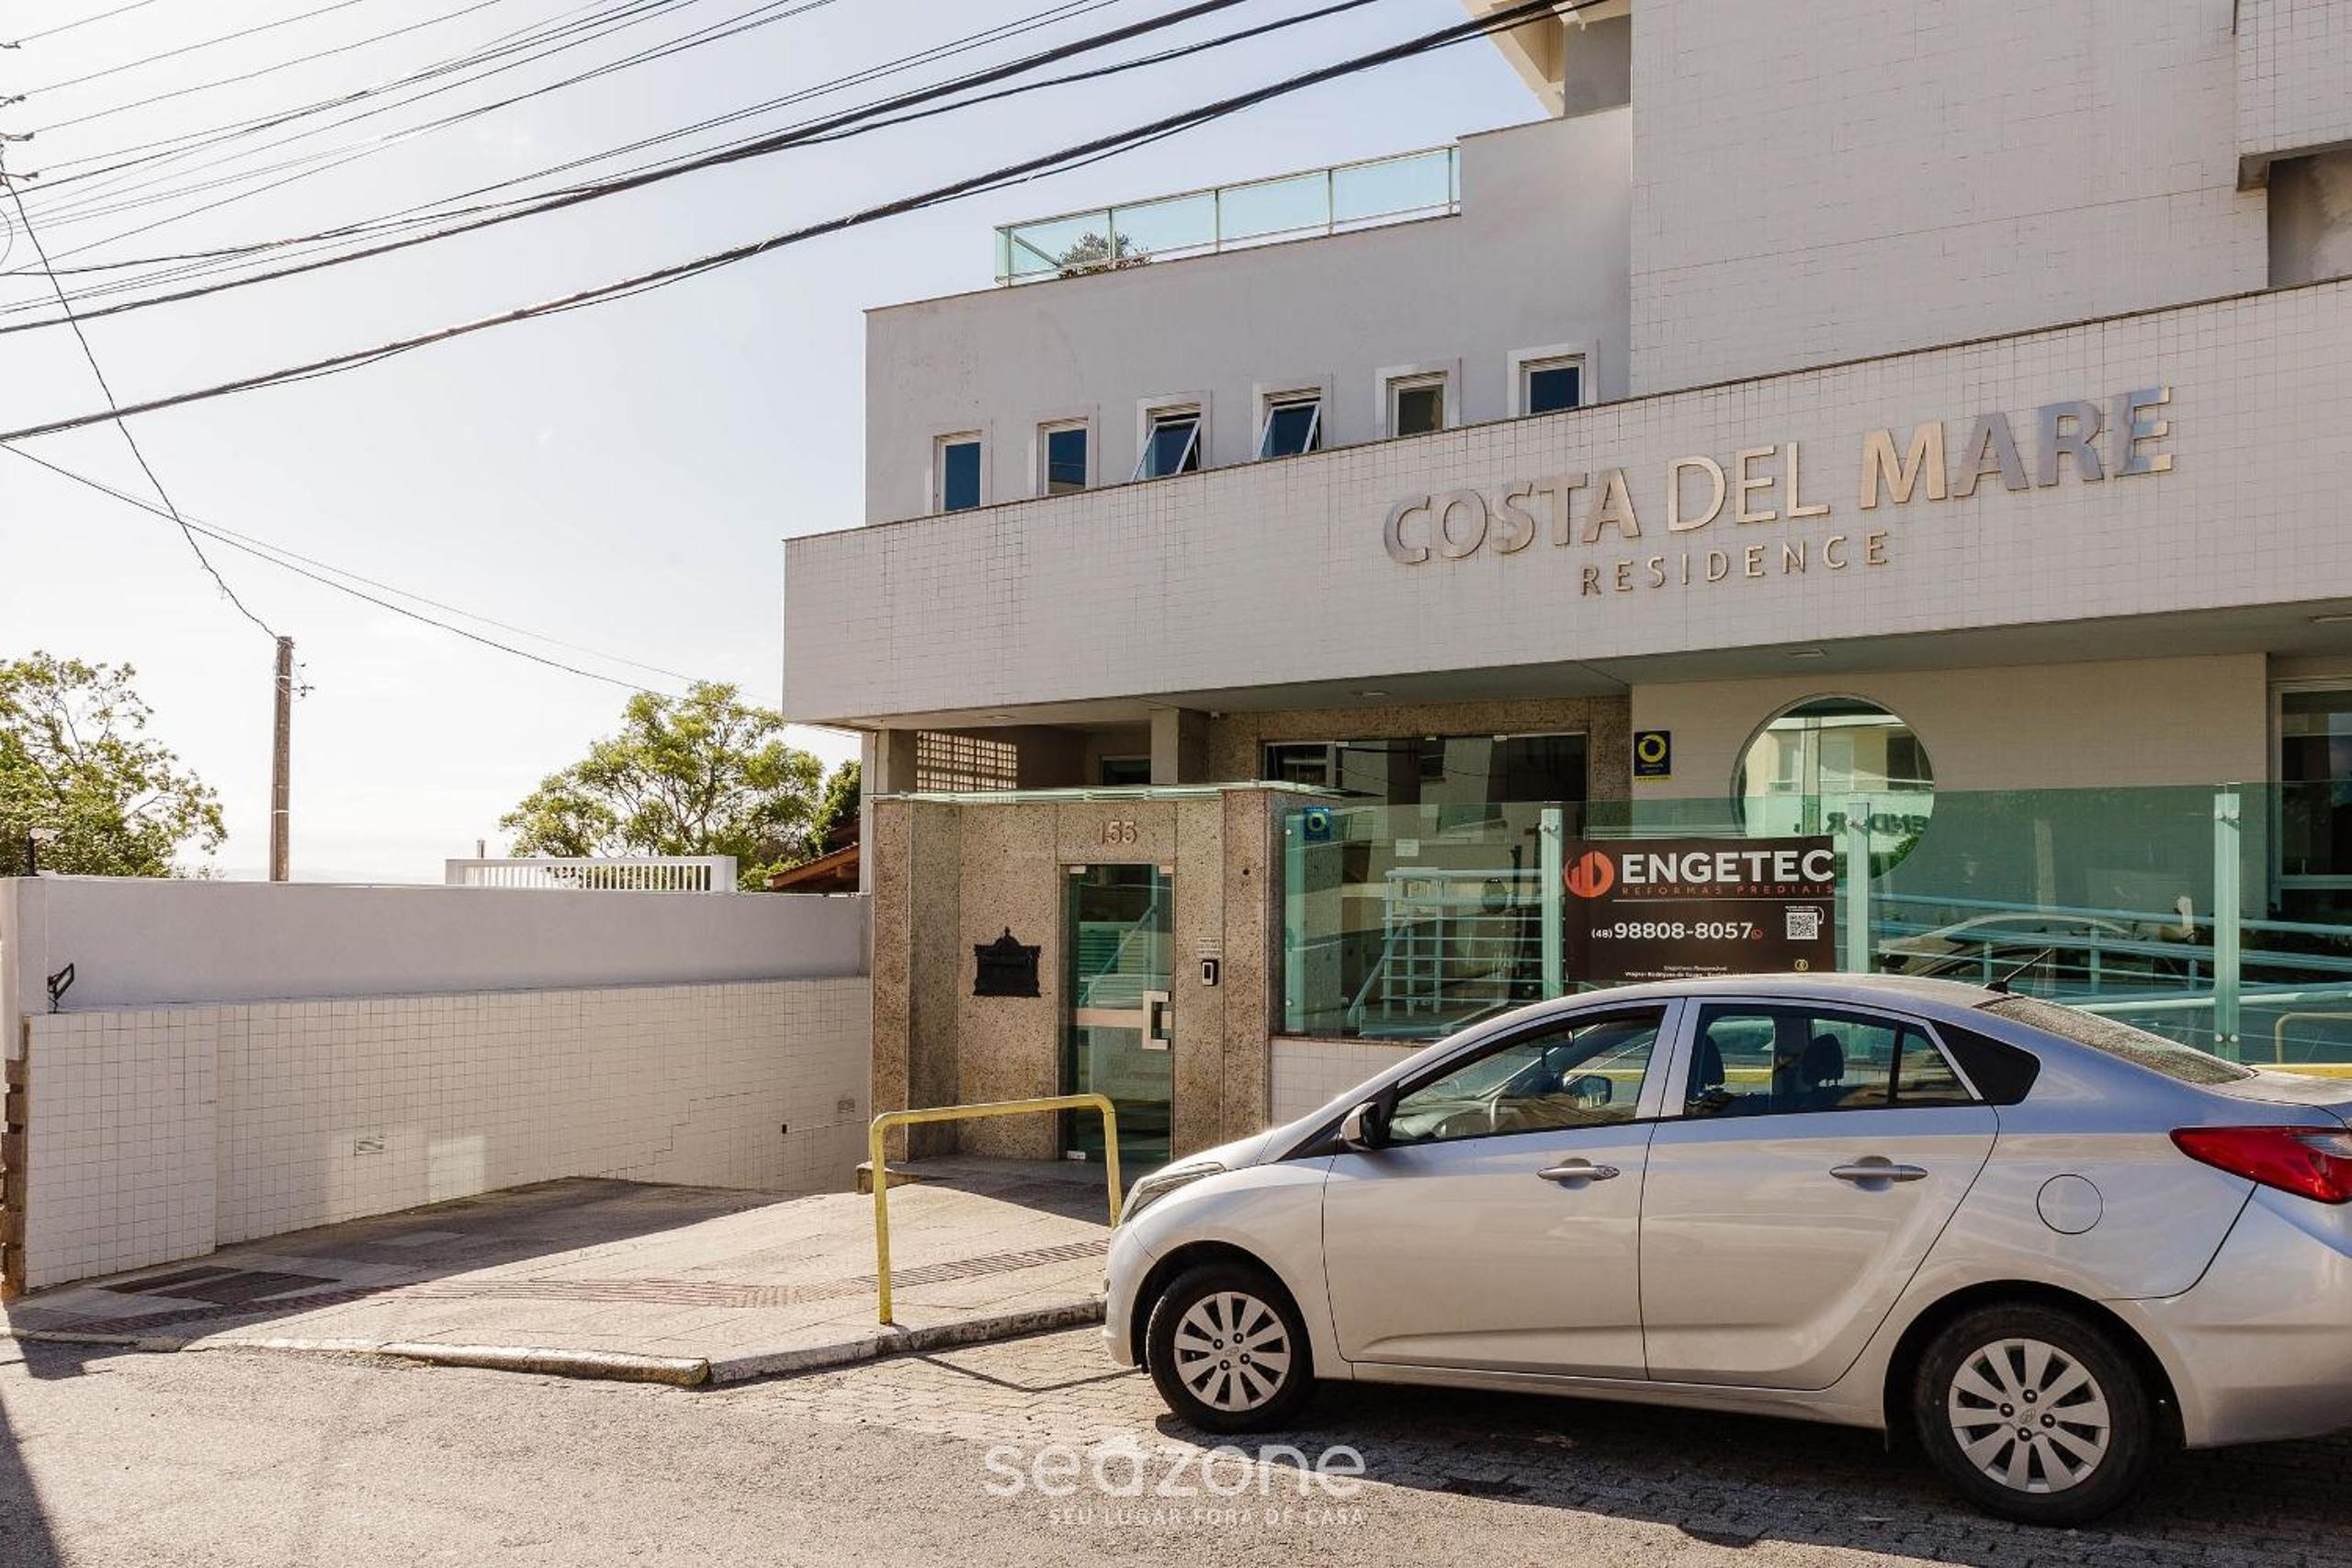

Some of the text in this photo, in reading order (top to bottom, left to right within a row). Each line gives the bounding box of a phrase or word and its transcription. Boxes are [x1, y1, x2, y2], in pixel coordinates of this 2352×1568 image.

[1384, 386, 2173, 566] COSTA DEL MARE
[1580, 532, 1888, 596] RESIDENCE
[1622, 849, 1835, 884] ENGETEC
[1622, 884, 1835, 897] REFORMAS PREDIAIS
[1591, 921, 1754, 940] (48) 98808-8057
